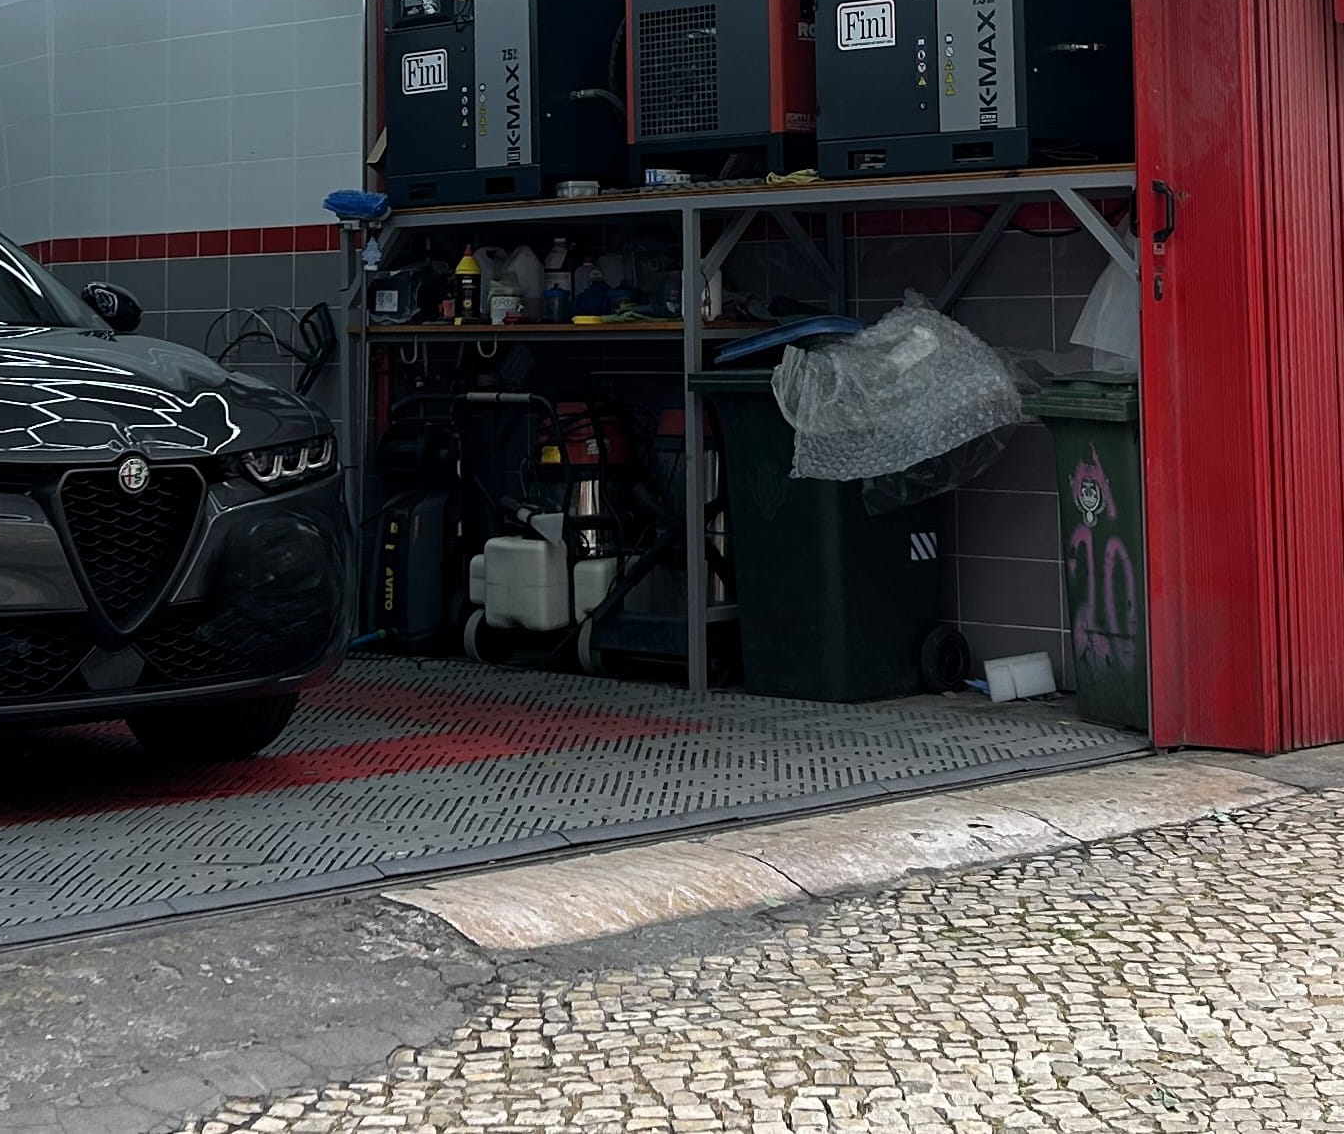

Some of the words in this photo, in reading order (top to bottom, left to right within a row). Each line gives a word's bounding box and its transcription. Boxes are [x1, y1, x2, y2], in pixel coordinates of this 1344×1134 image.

[844, 8, 887, 41] Fini
[406, 55, 444, 87] Fini
[977, 8, 997, 113] K-MAX
[506, 64, 520, 152] K-MAX
